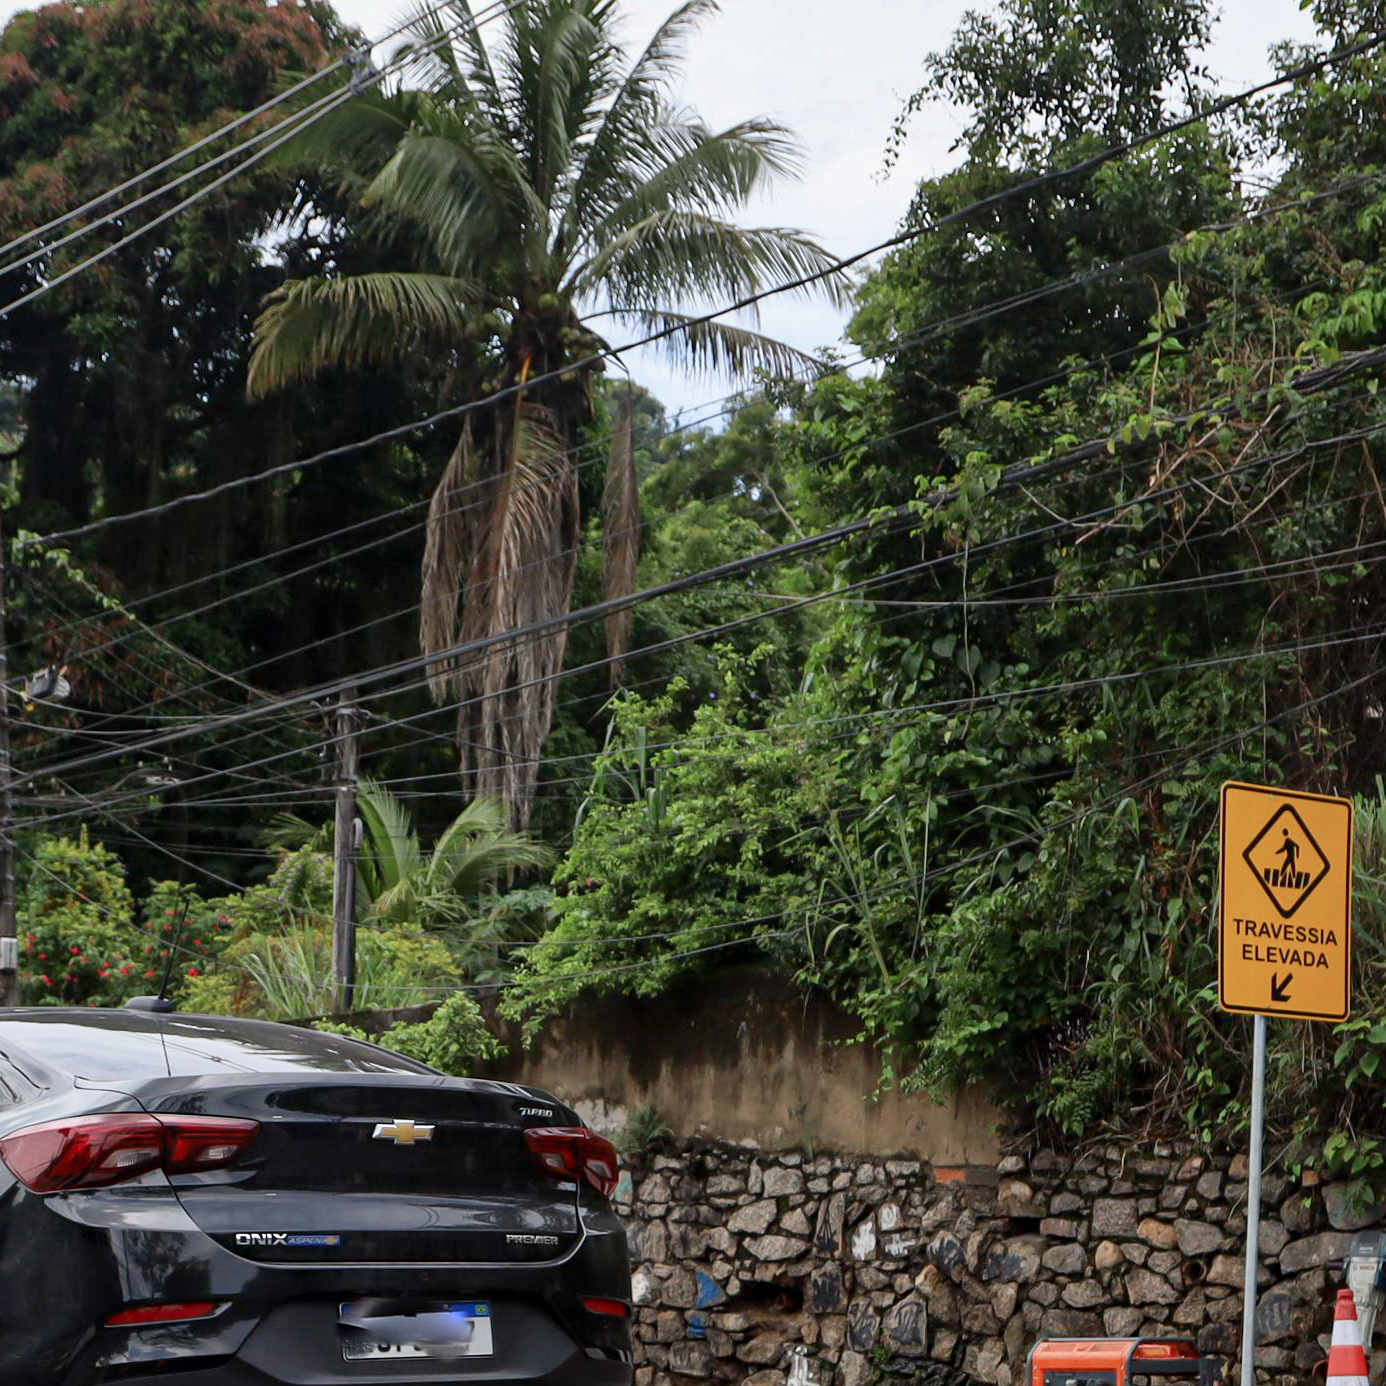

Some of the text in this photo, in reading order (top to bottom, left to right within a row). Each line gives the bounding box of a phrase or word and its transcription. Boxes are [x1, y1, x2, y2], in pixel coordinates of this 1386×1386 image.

[1233, 918, 1338, 946] TRAVESSIA
[1242, 944, 1329, 969] ELEVADA
[235, 1233, 288, 1245] ONIX
[506, 1234, 558, 1245] PREMIER
